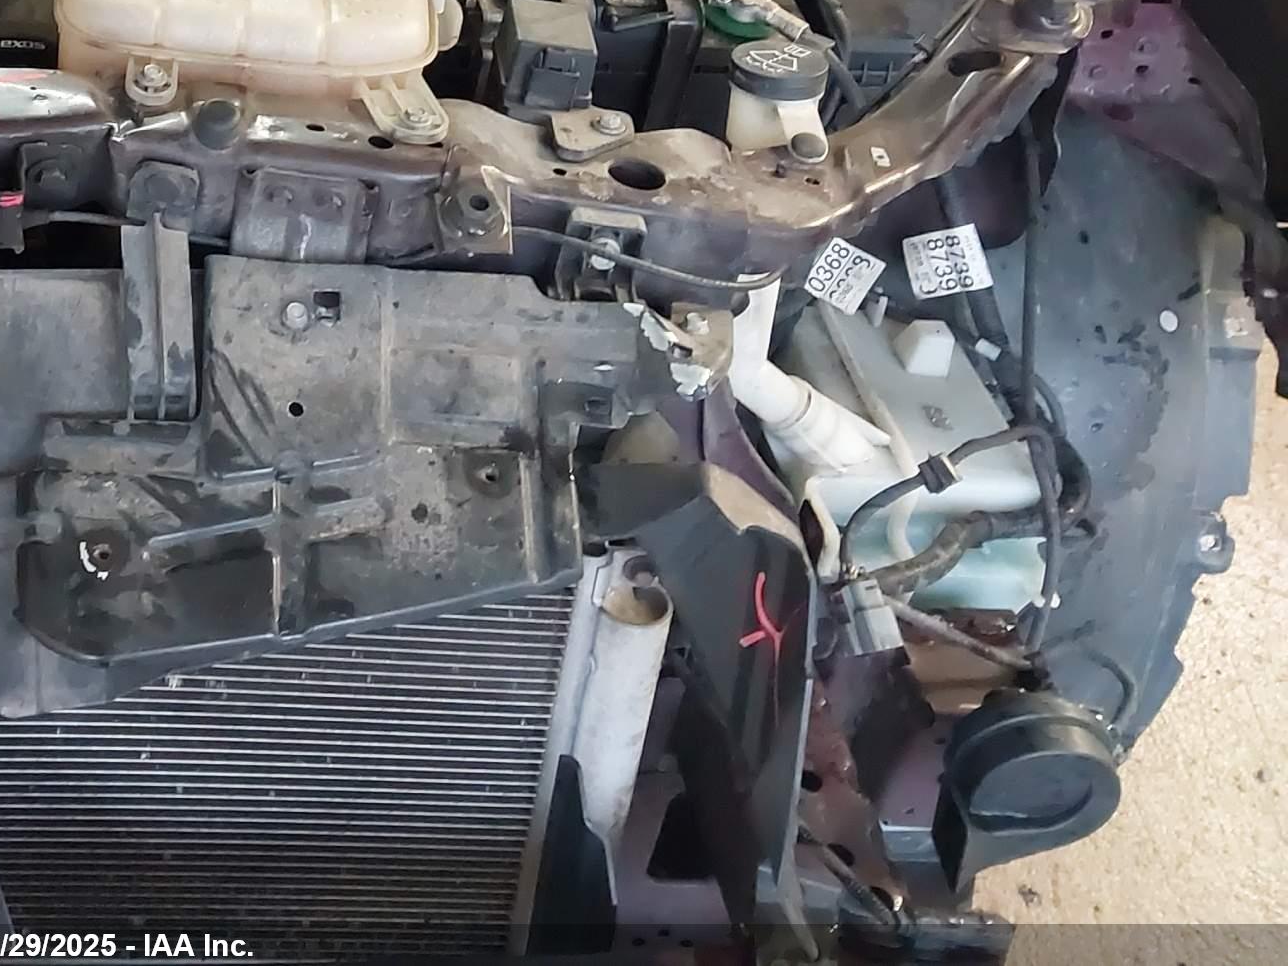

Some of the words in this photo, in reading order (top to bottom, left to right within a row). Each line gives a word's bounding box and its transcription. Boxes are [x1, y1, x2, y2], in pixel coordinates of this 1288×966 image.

[808, 243, 850, 292] 0368
[926, 238, 958, 290] 8739
[945, 235, 974, 288] 8739
